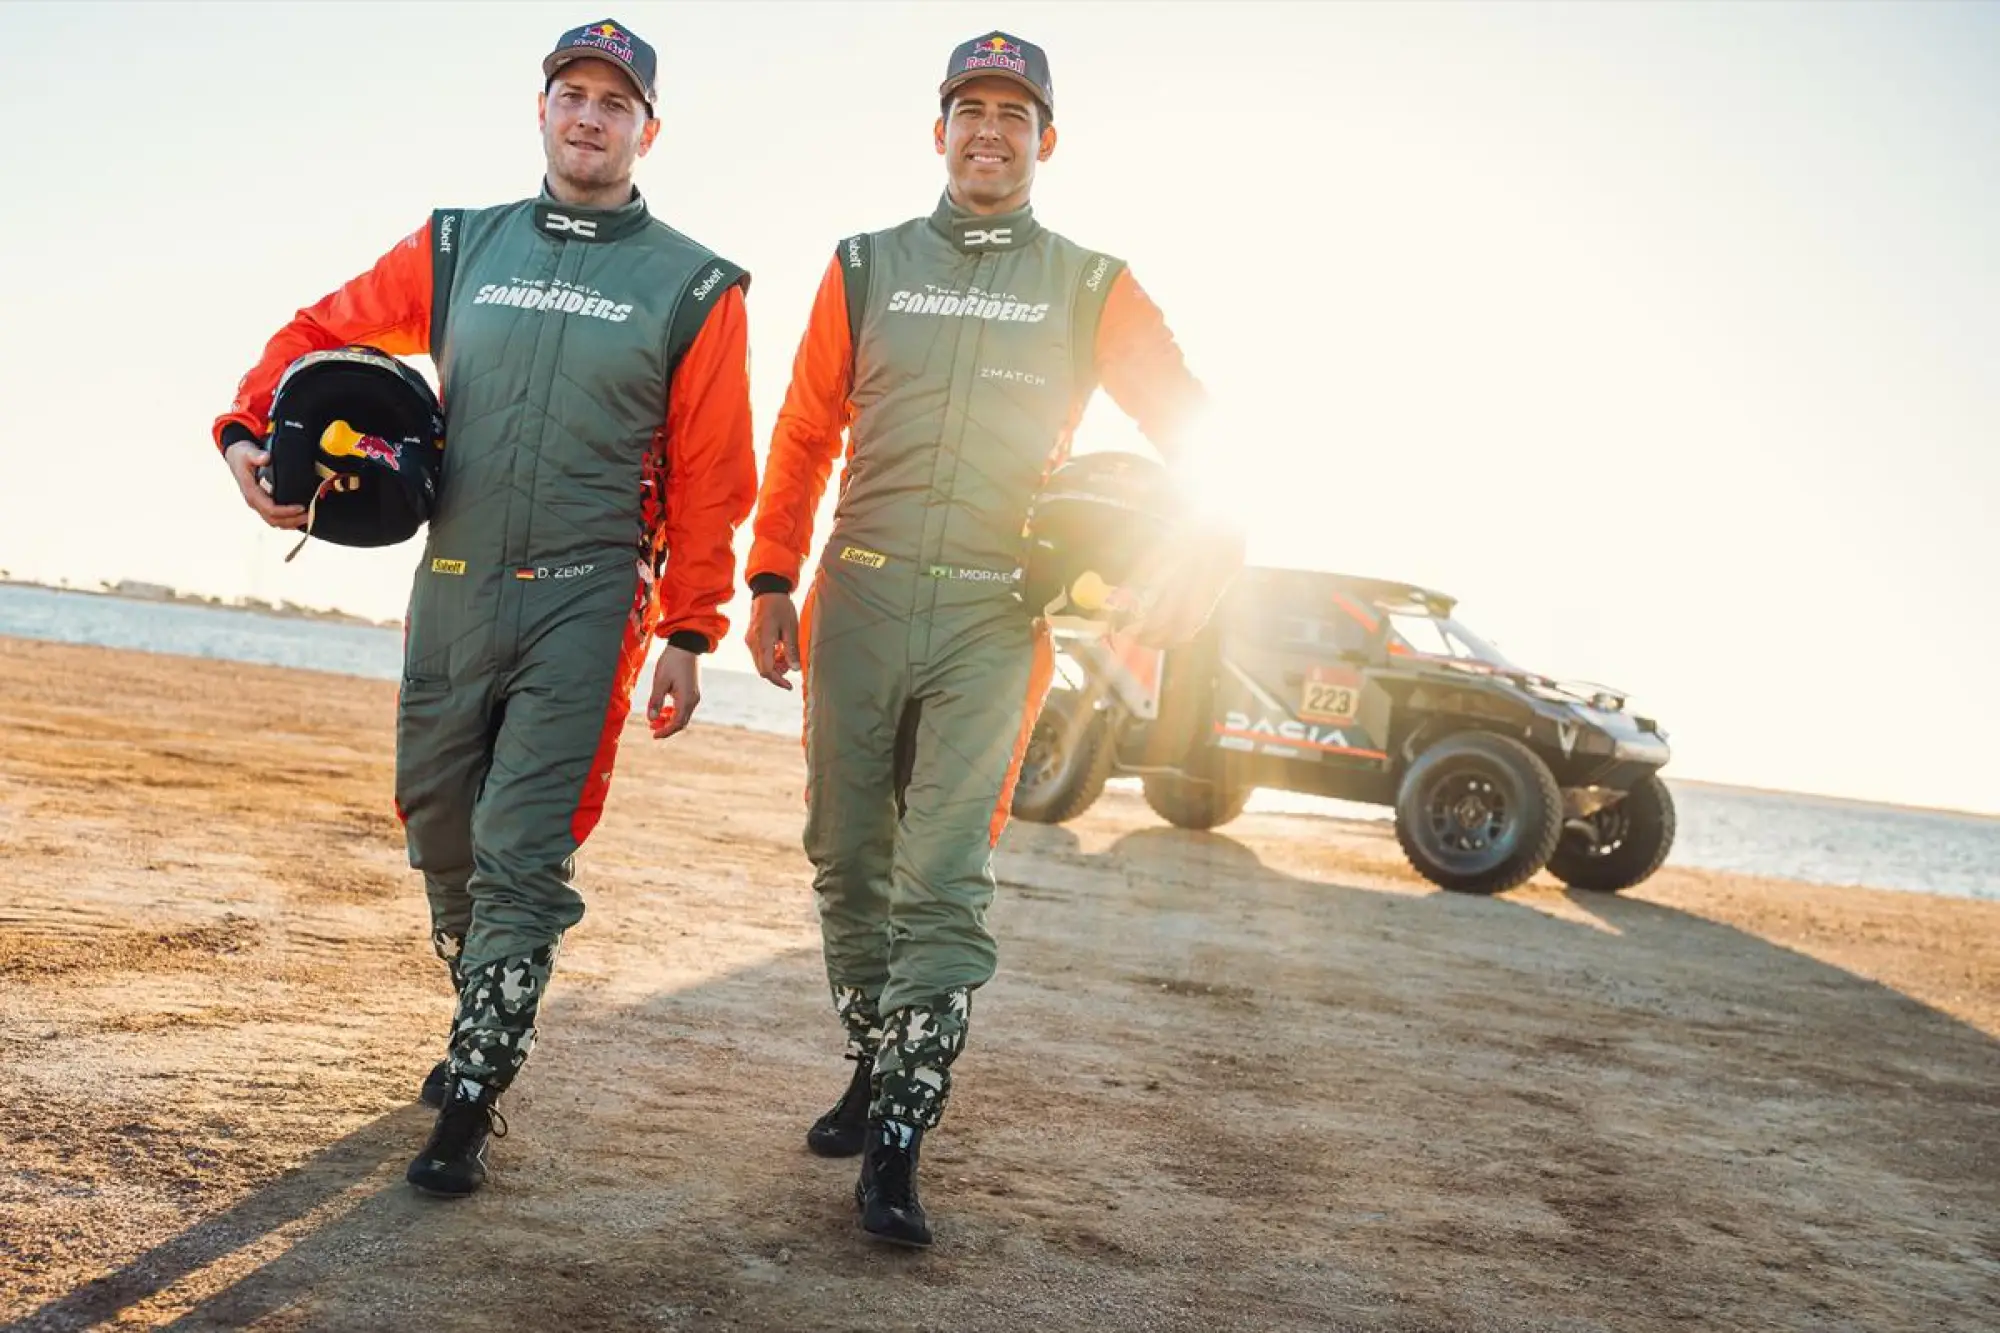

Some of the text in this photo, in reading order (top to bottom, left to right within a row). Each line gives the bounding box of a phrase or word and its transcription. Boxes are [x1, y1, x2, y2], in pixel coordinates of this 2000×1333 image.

[964, 53, 1026, 74] Red Bull
[439, 214, 456, 254] Sabelt
[511, 277, 546, 288] THE
[692, 267, 725, 301] Sabelt
[924, 284, 961, 295] THE
[472, 284, 633, 322] SANDRIDERS
[887, 290, 1050, 322] SANDRIDERS
[844, 548, 883, 567] Sabelt
[1308, 686, 1351, 714] 223
[1224, 711, 1349, 748] DACIA
